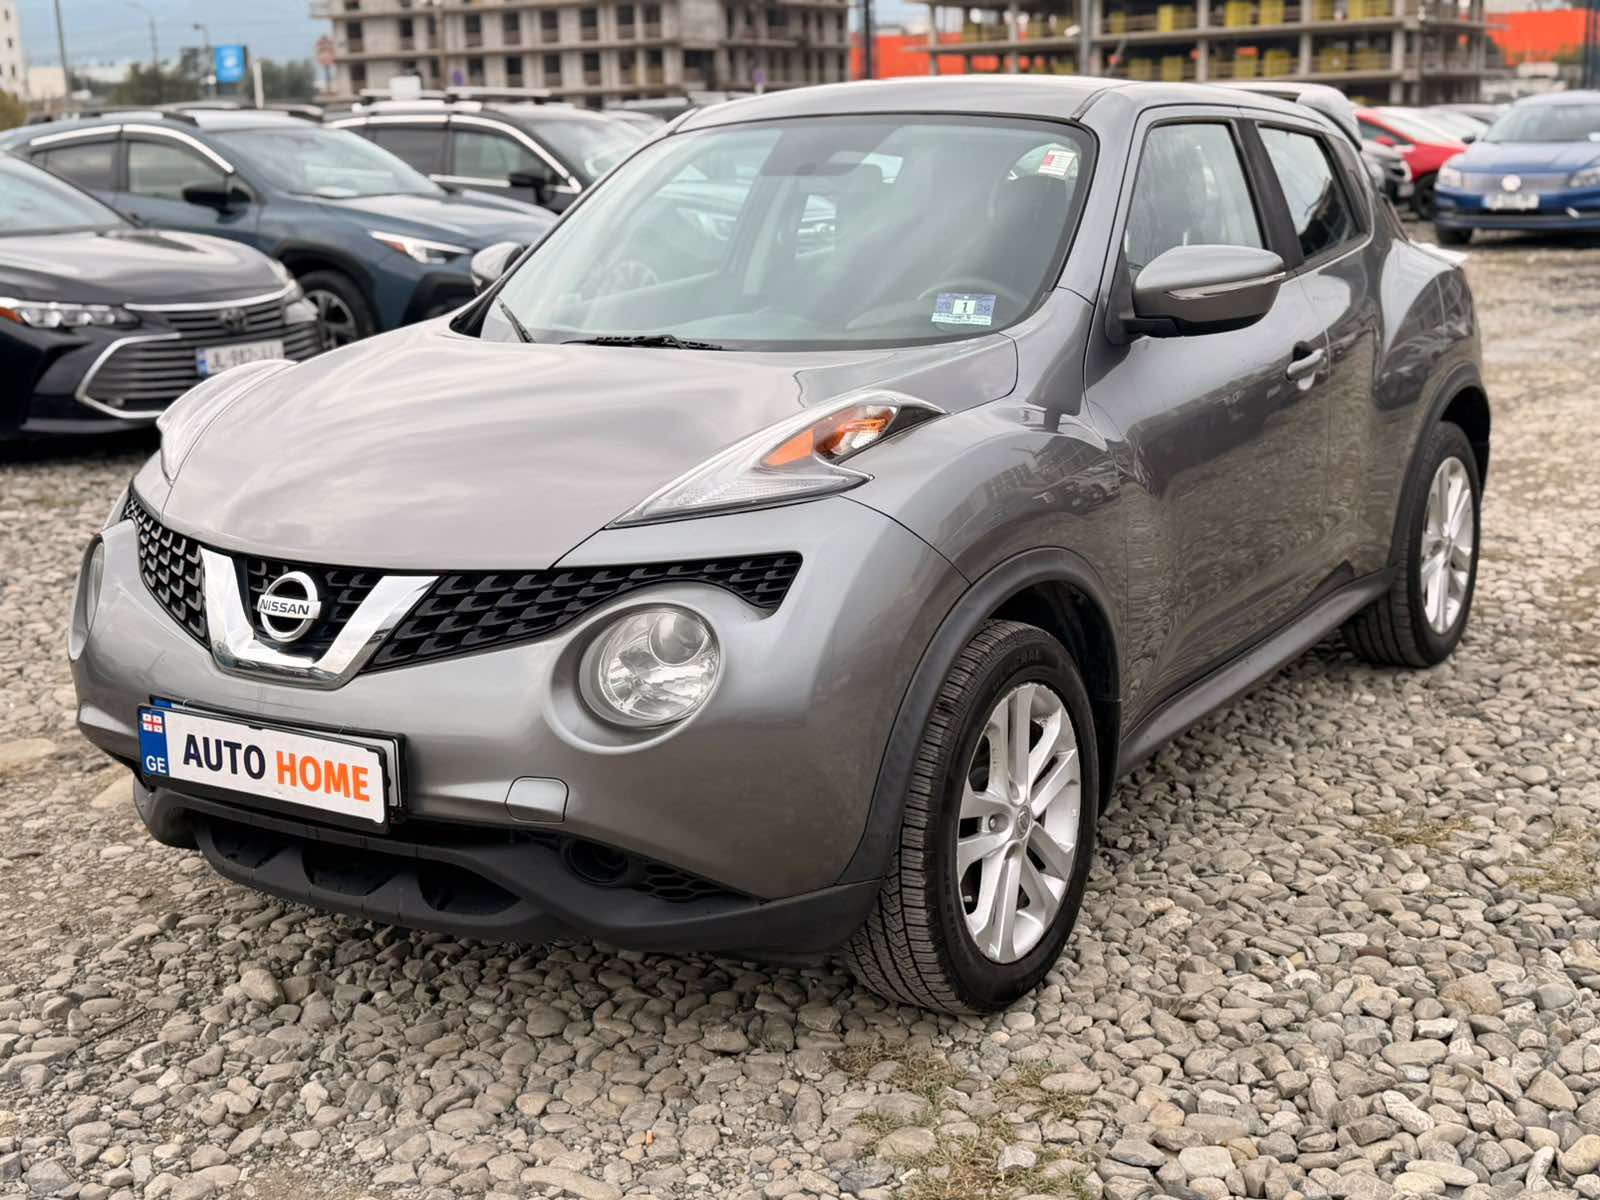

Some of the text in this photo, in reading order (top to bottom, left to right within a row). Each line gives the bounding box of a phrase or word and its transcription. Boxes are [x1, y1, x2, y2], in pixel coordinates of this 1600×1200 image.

[260, 599, 310, 615] NISSAN
[146, 755, 166, 774] GE
[183, 733, 370, 802] AUTO HOME
